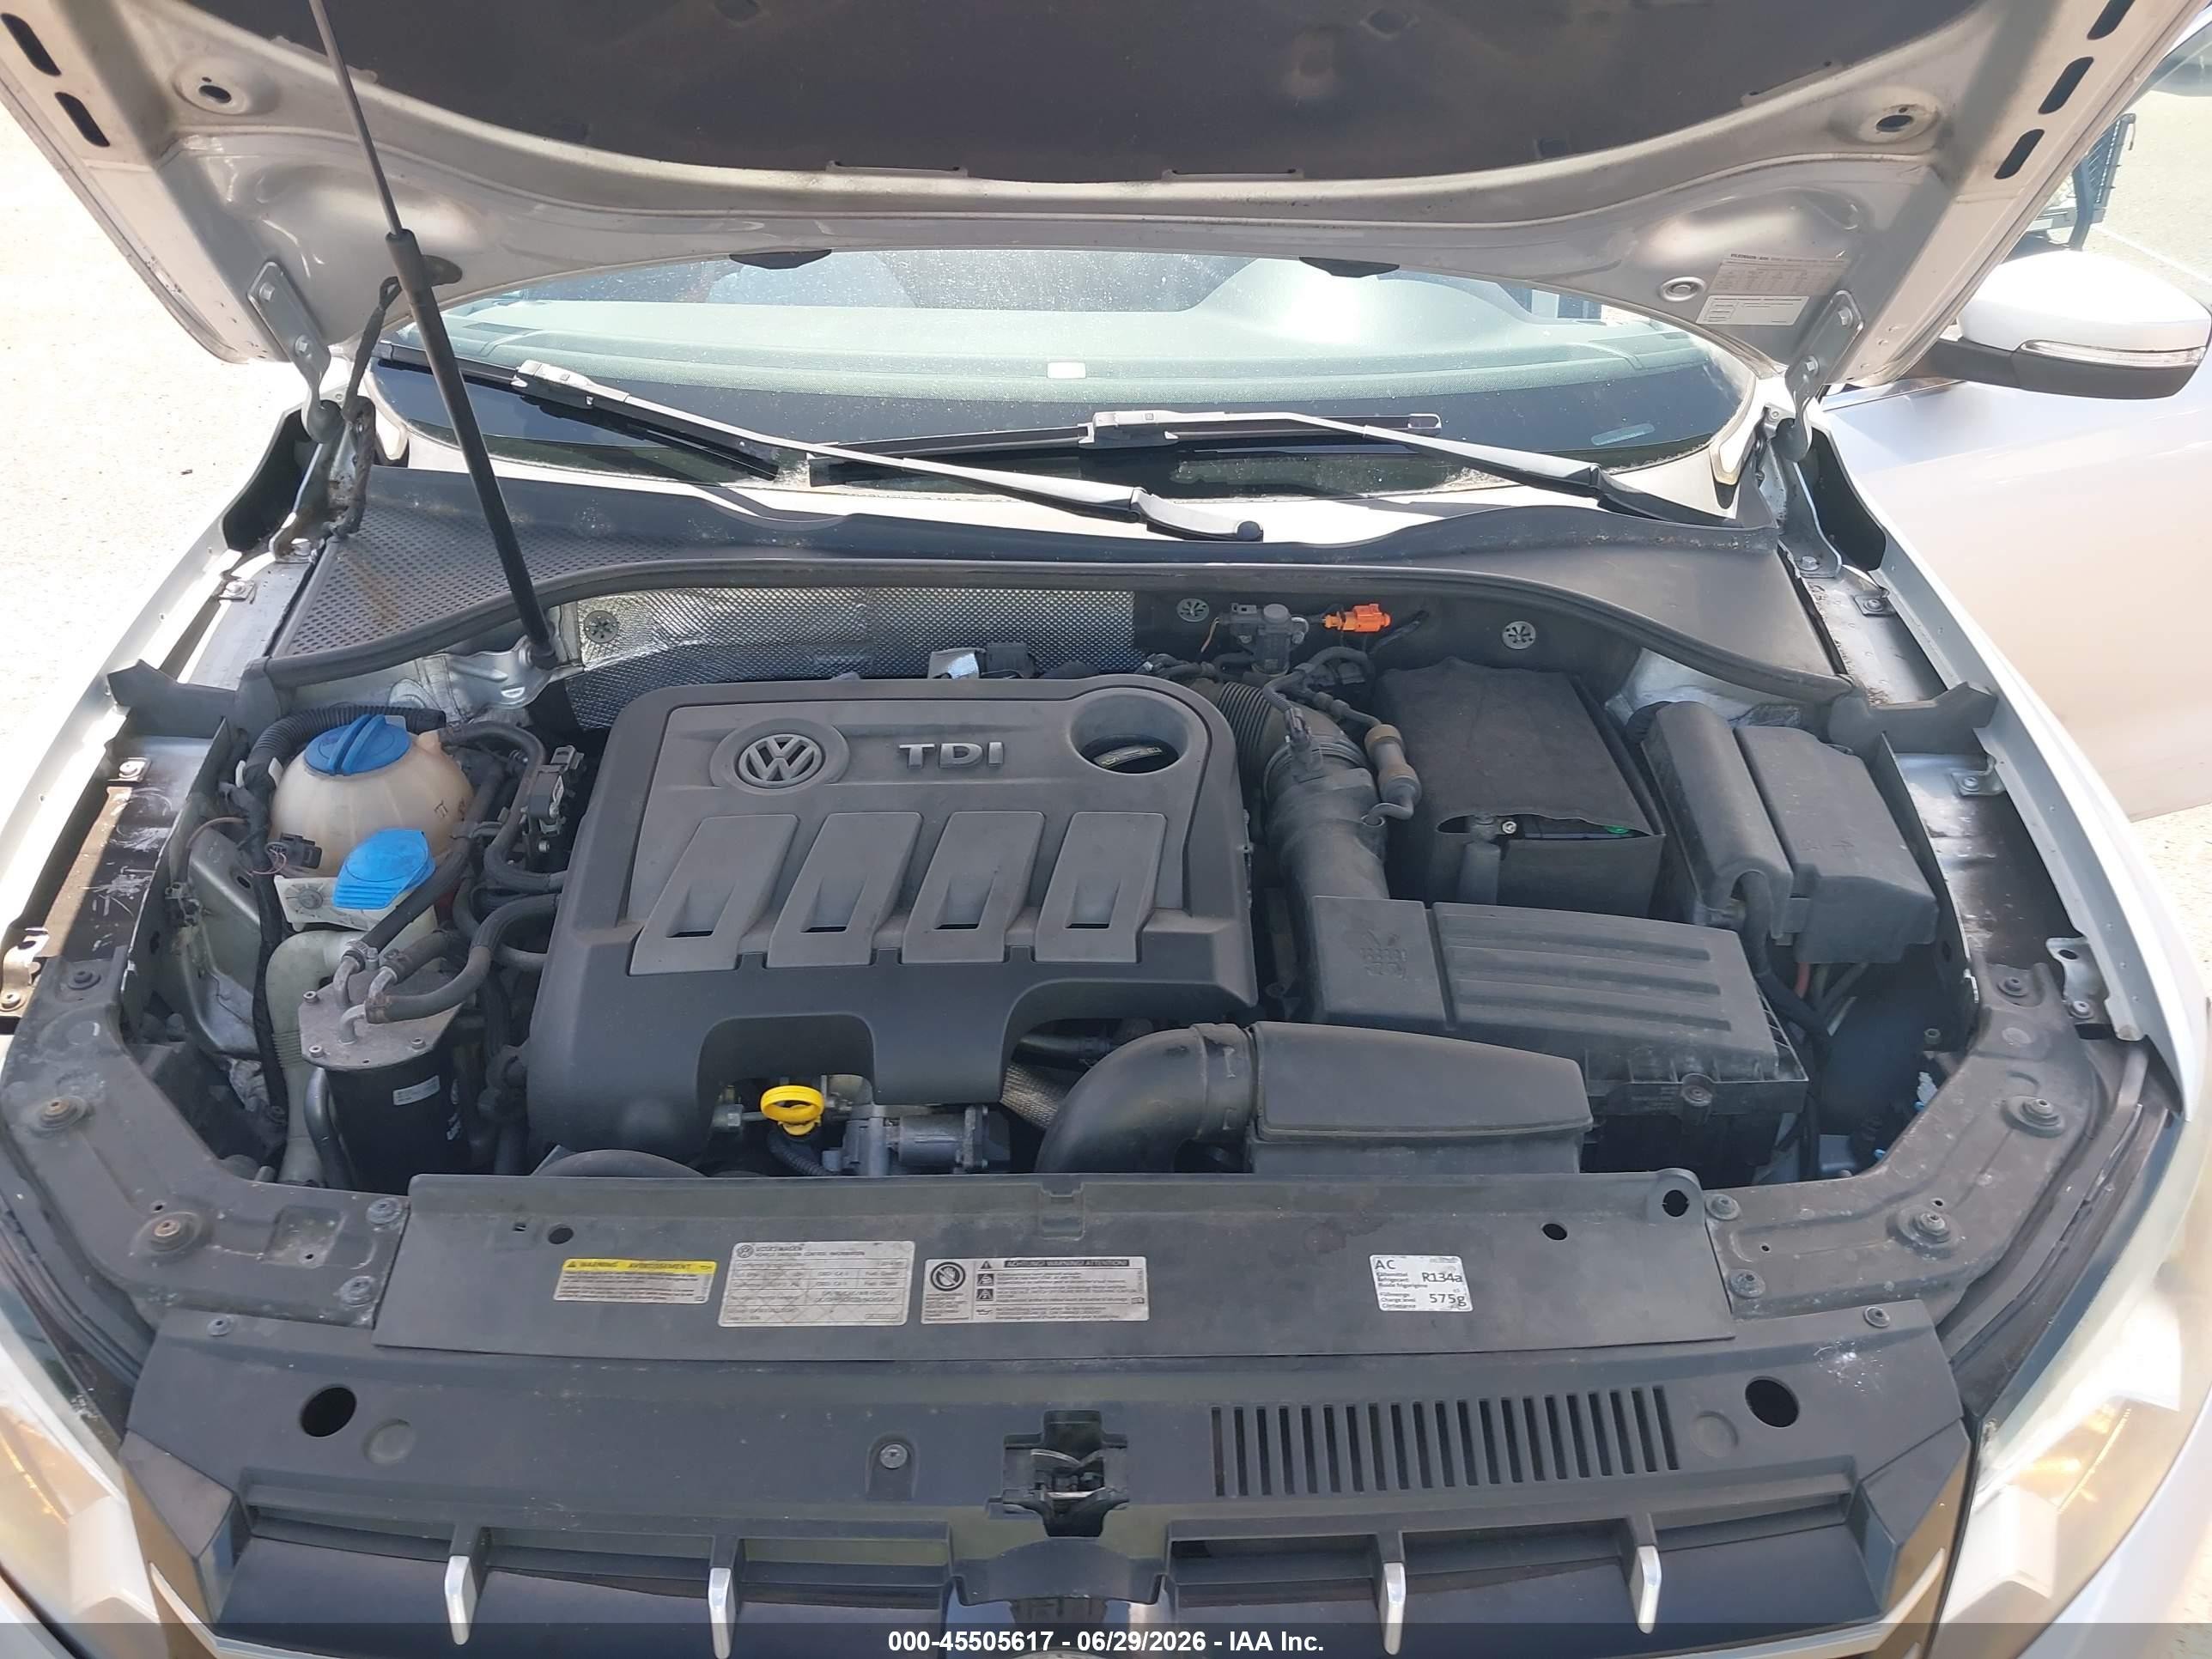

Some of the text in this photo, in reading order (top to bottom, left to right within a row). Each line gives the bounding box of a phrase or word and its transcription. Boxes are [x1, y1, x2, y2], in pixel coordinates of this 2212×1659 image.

[899, 741, 1004, 769] TDI
[1375, 1260, 1396, 1269] AC
[1422, 1273, 1463, 1283] R134a
[1429, 1293, 1467, 1306] 575g
